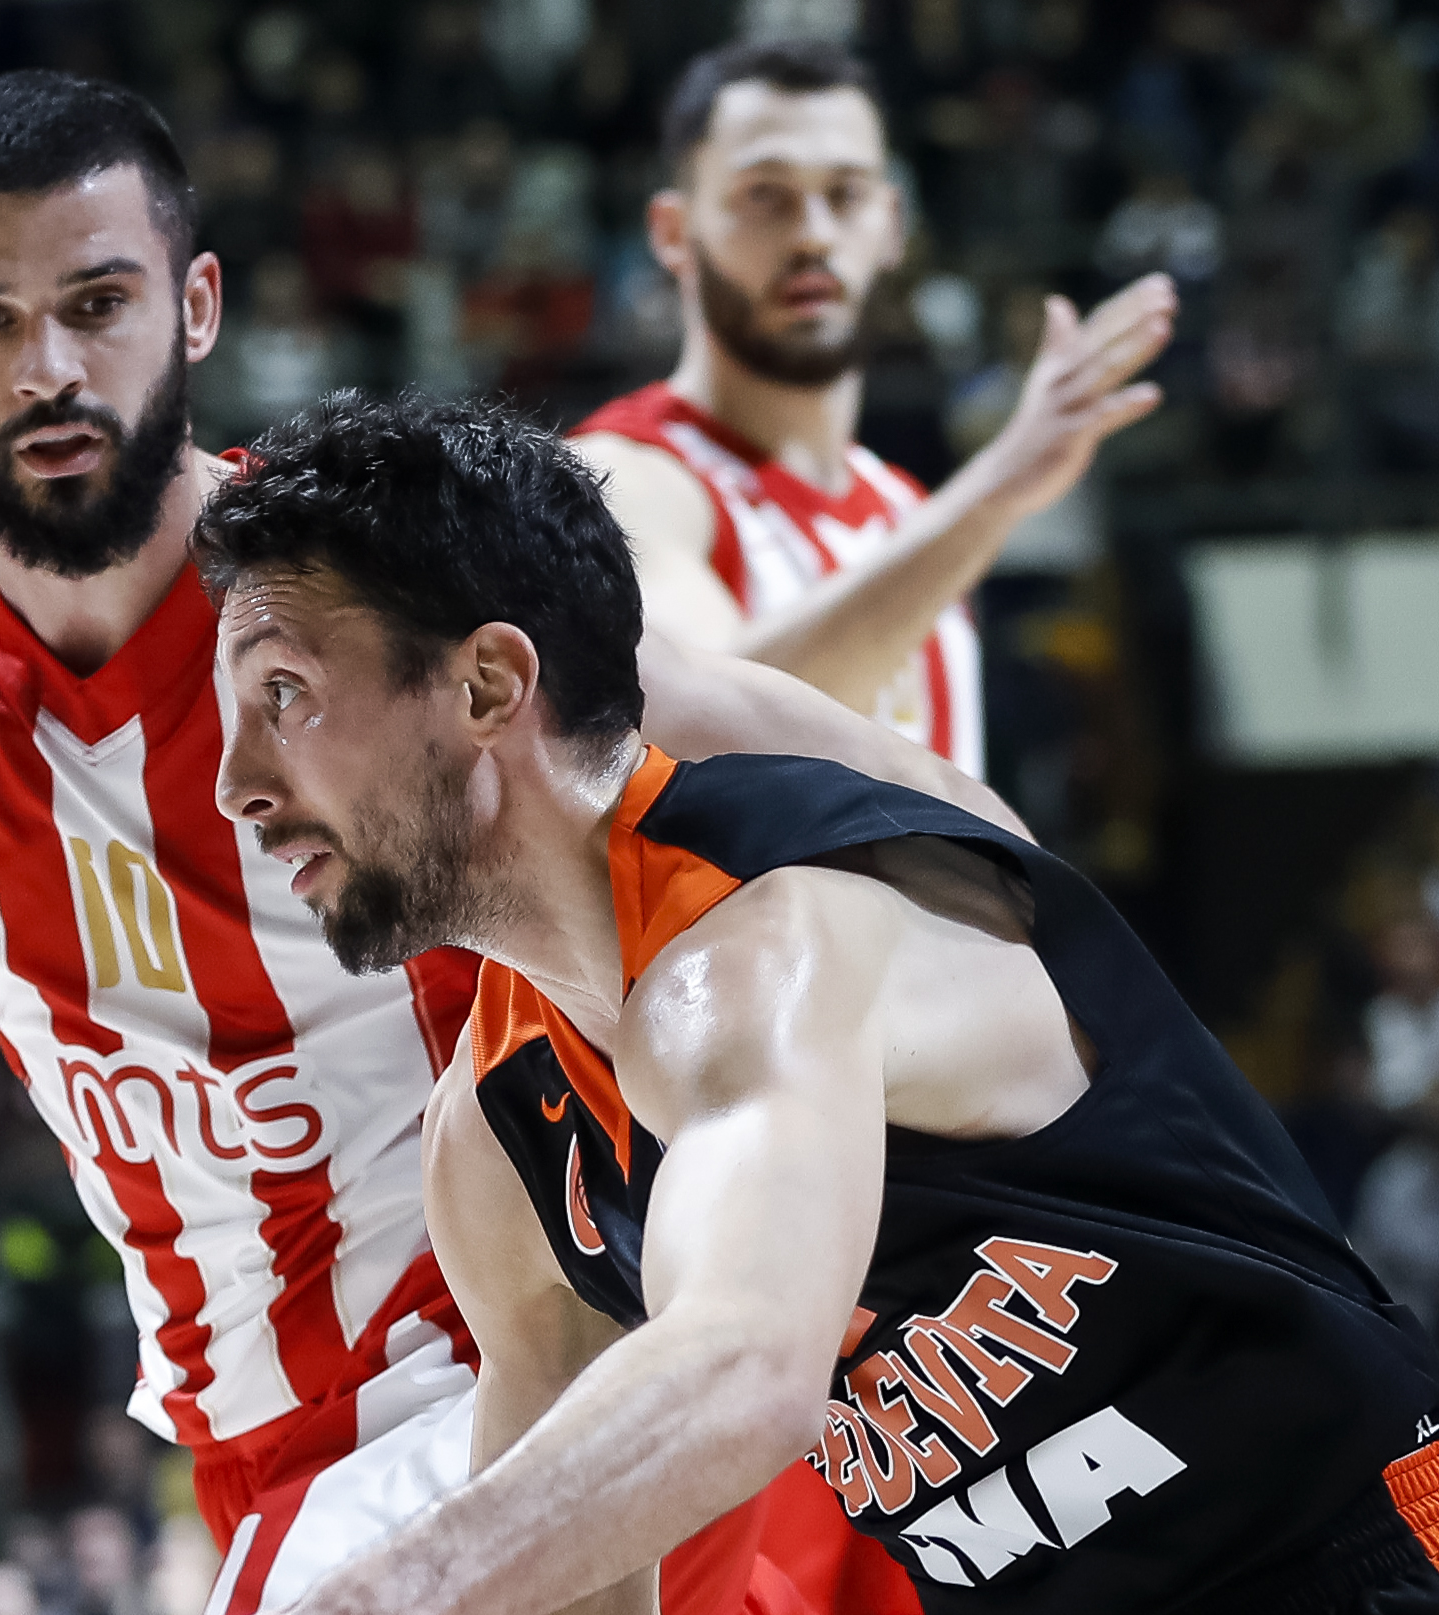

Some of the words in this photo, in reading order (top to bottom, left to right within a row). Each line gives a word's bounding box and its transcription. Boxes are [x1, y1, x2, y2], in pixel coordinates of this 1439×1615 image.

[69, 837, 186, 993] 10
[53, 1053, 328, 1165] mts
[805, 1235, 1119, 1518] EDEVITA
